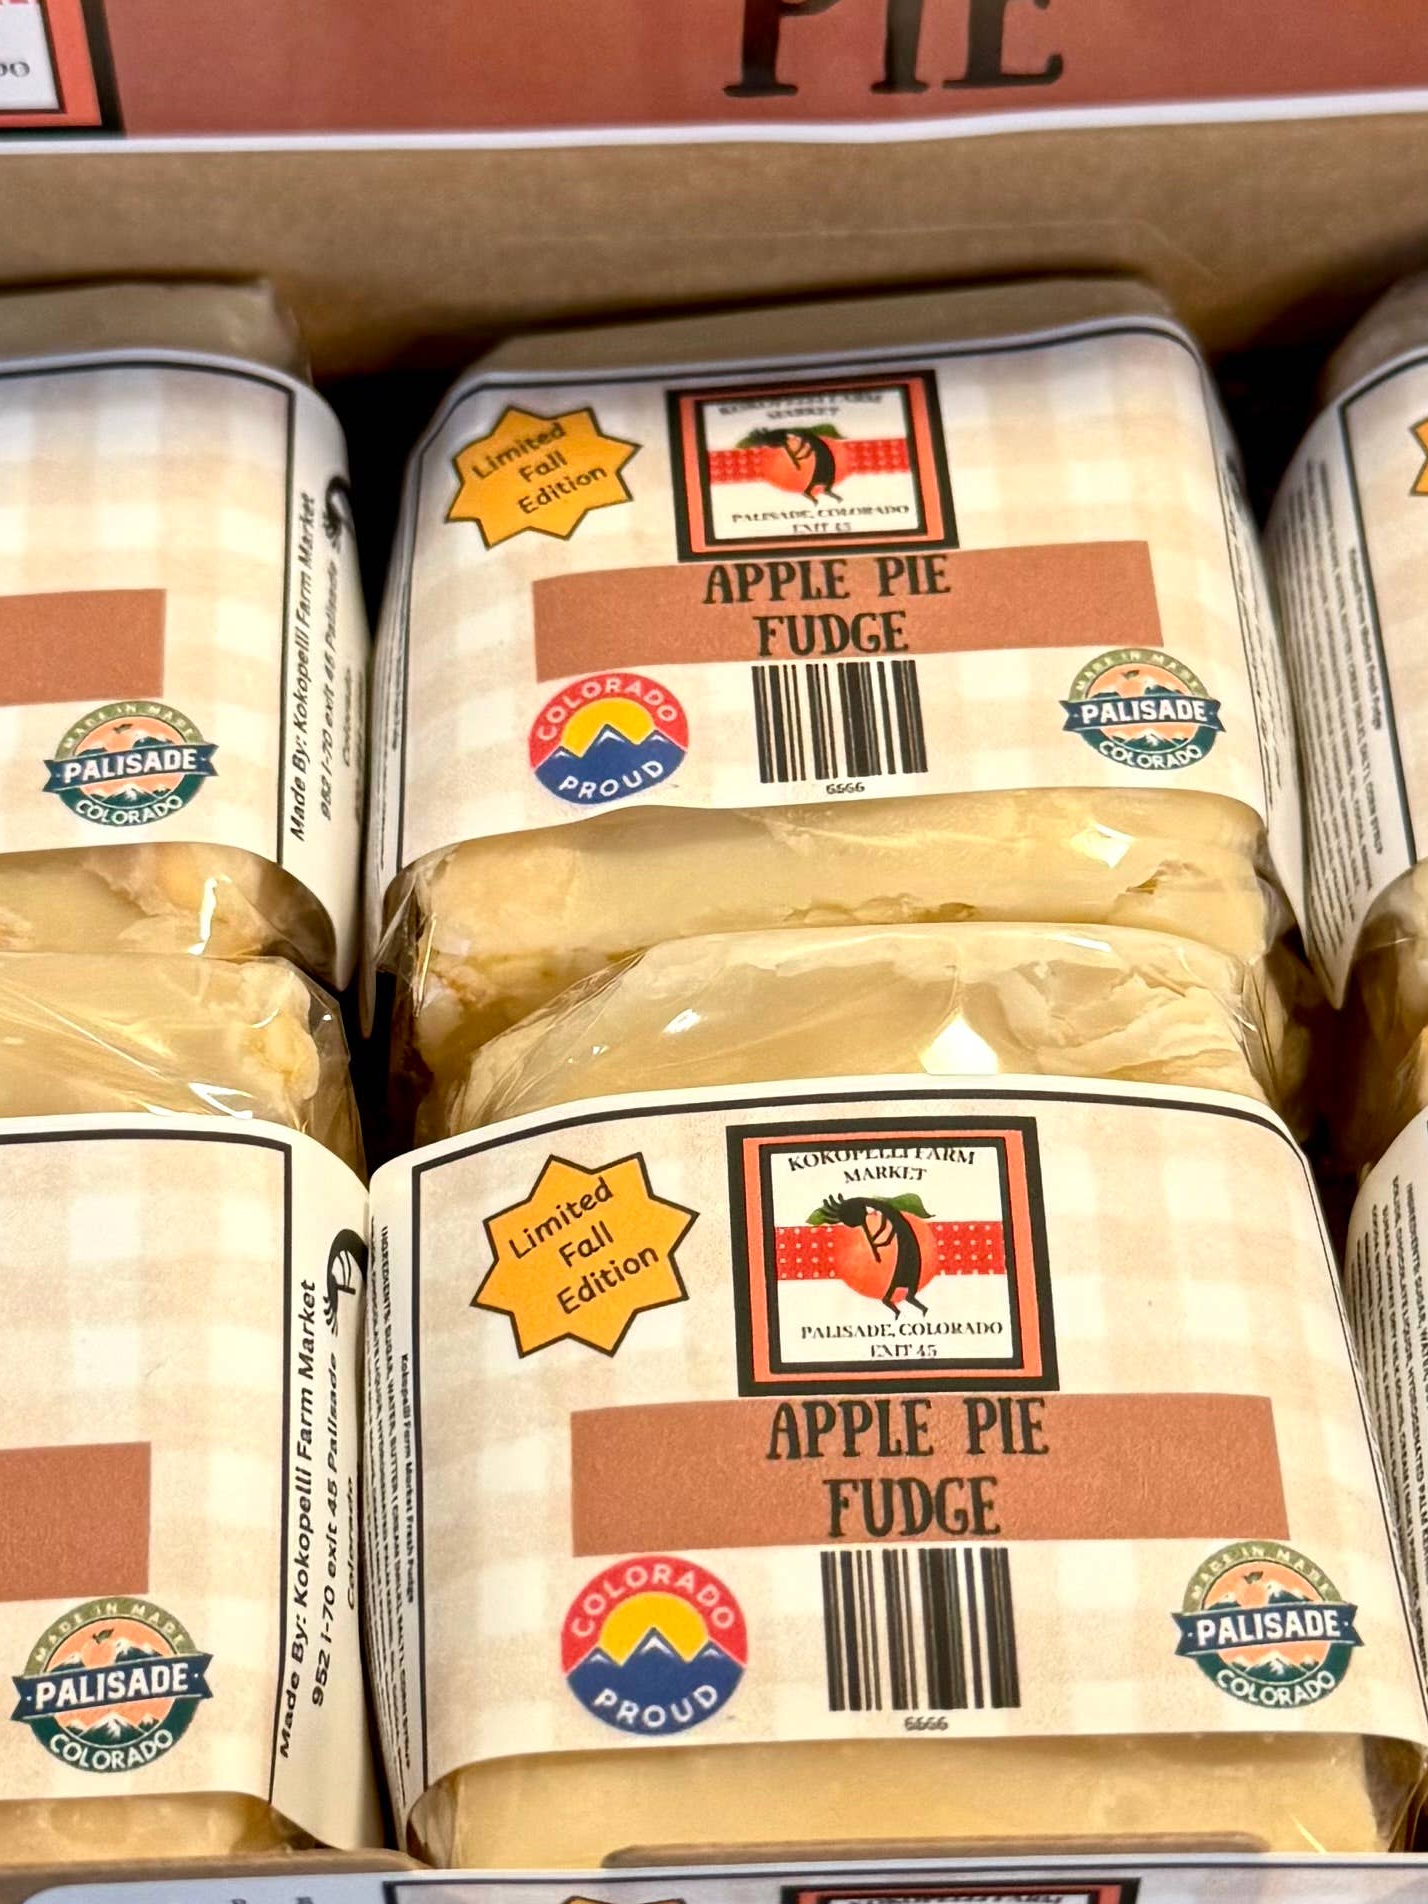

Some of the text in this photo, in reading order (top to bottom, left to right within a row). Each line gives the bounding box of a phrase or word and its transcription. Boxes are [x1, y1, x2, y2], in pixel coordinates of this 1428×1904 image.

[472, 422, 567, 481] Limited
[518, 451, 568, 483] Fall
[519, 465, 607, 515] Edition
[703, 554, 951, 605] APPLE PIE
[752, 612, 909, 657] FUDGE
[536, 676, 678, 742] COLORADO
[1081, 697, 1208, 725] PALISADE
[63, 746, 198, 783] PALISADE
[558, 759, 664, 799] PROUD
[1097, 741, 1204, 770] COLORADO
[75, 794, 184, 825] COLORADO
[843, 1165, 927, 1184] MARKET
[508, 1176, 615, 1261] Limited
[558, 1220, 615, 1271] Fall
[557, 1244, 660, 1317] Edition
[298, 1279, 316, 1380] Market
[899, 1321, 1003, 1338] COLORADO
[296, 1387, 313, 1462] Farm
[766, 1396, 1049, 1461] APPLE PIE
[822, 1475, 1001, 1537] FUDGE
[572, 1560, 735, 1638] COLORADO
[290, 1614, 309, 1665] By:
[1196, 1609, 1341, 1646] PALISADE
[35, 1663, 190, 1712] PALISADE
[312, 1649, 330, 1707] 952
[1215, 1668, 1335, 1708] COLORADO
[279, 1670, 300, 1759] Made
[593, 1682, 719, 1729] PROUD
[49, 1728, 175, 1770] COLORADO
